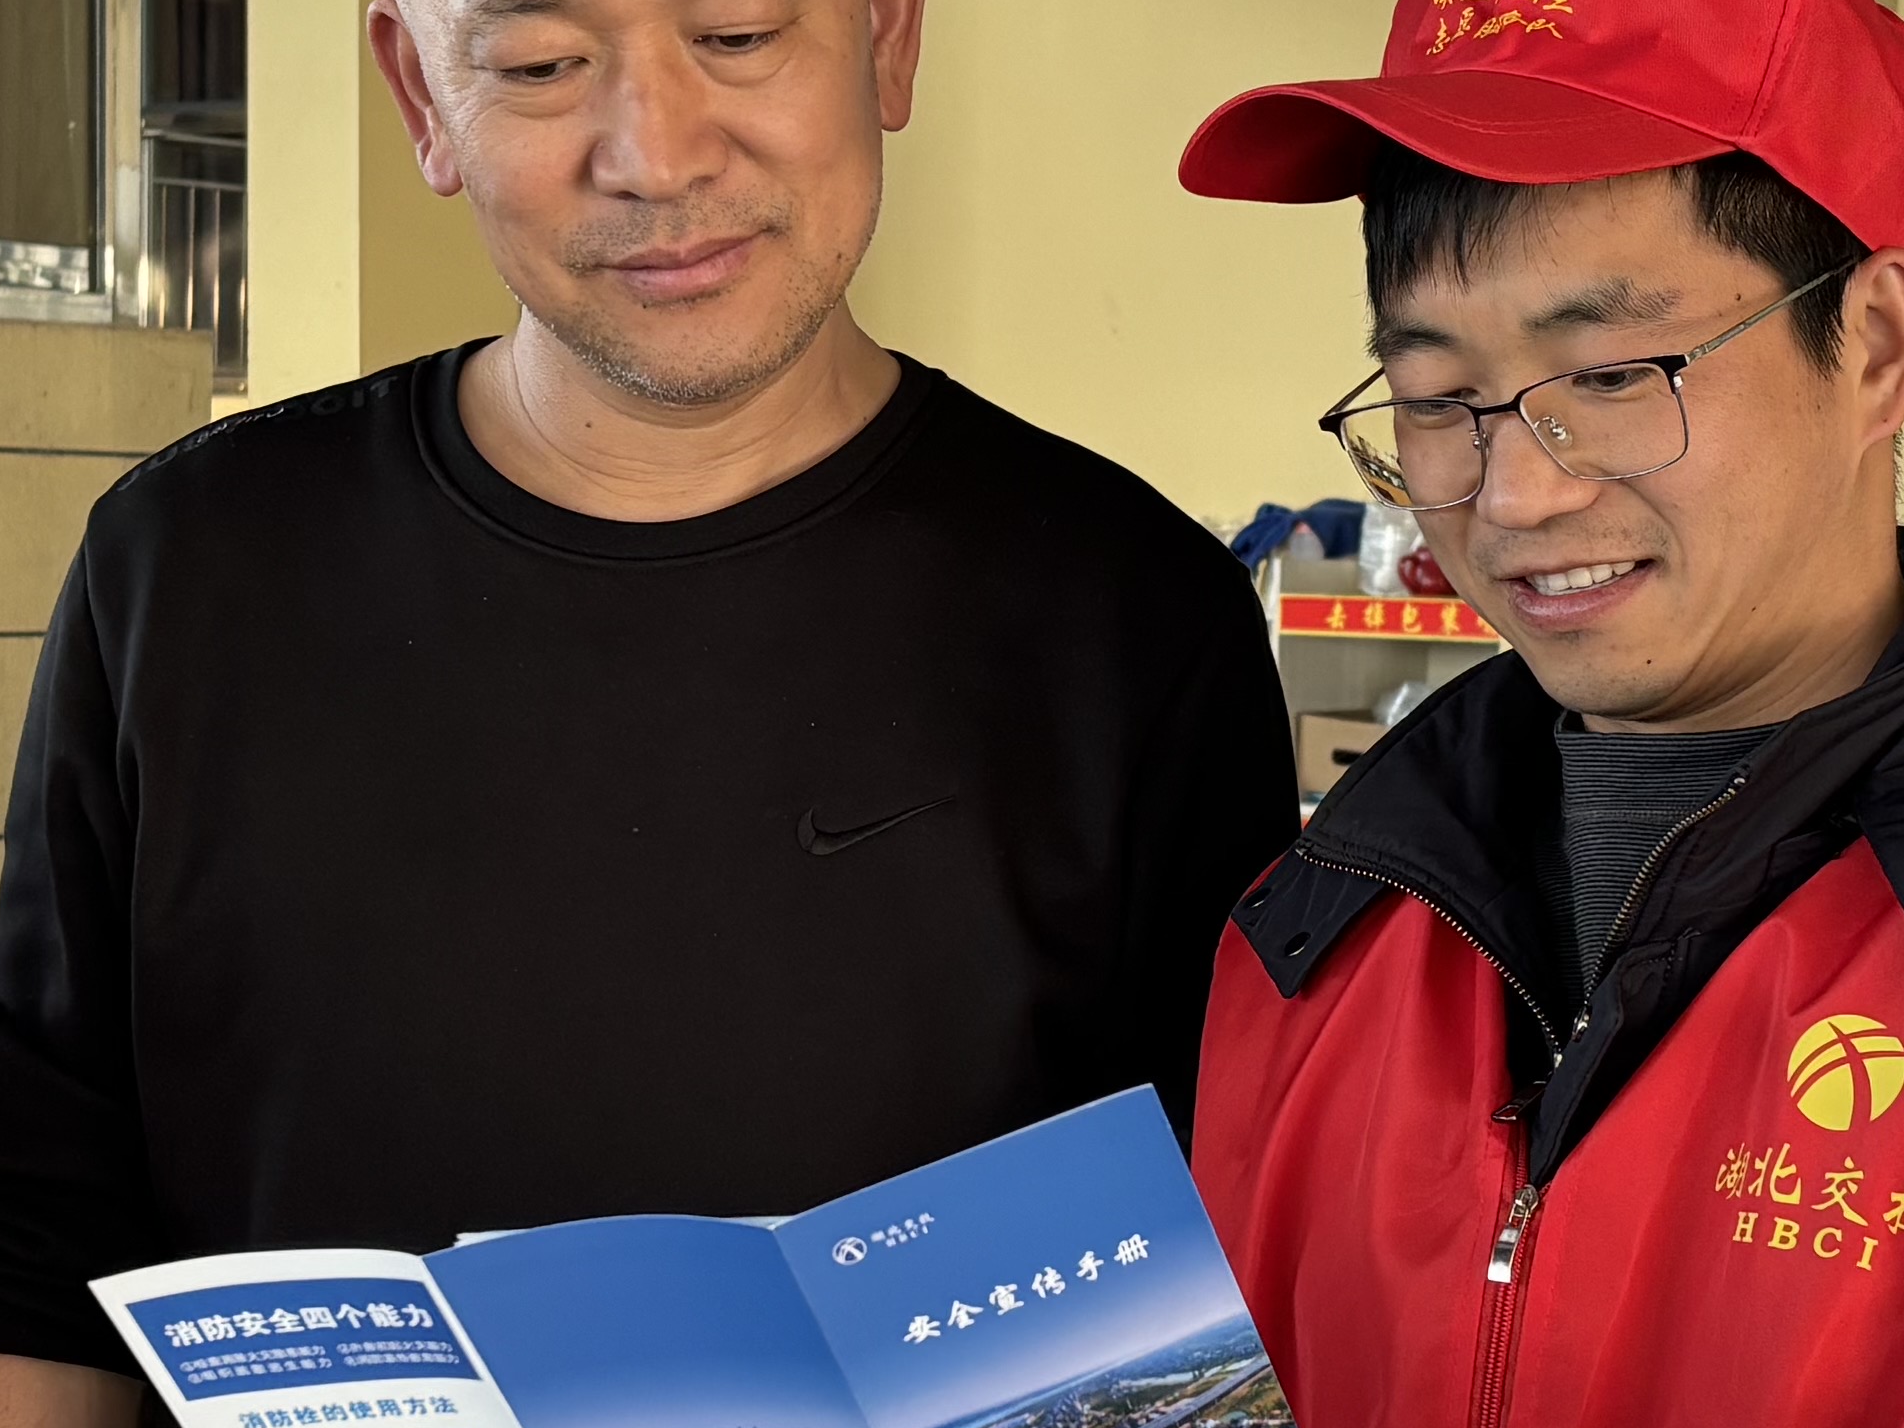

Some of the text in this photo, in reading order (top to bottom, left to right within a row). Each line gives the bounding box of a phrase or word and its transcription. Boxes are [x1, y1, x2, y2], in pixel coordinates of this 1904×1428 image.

[1731, 1210, 1880, 1272] HBCI
[902, 1233, 1150, 1345] 安全宣传手册
[163, 1302, 435, 1349] 消防安全四个能力
